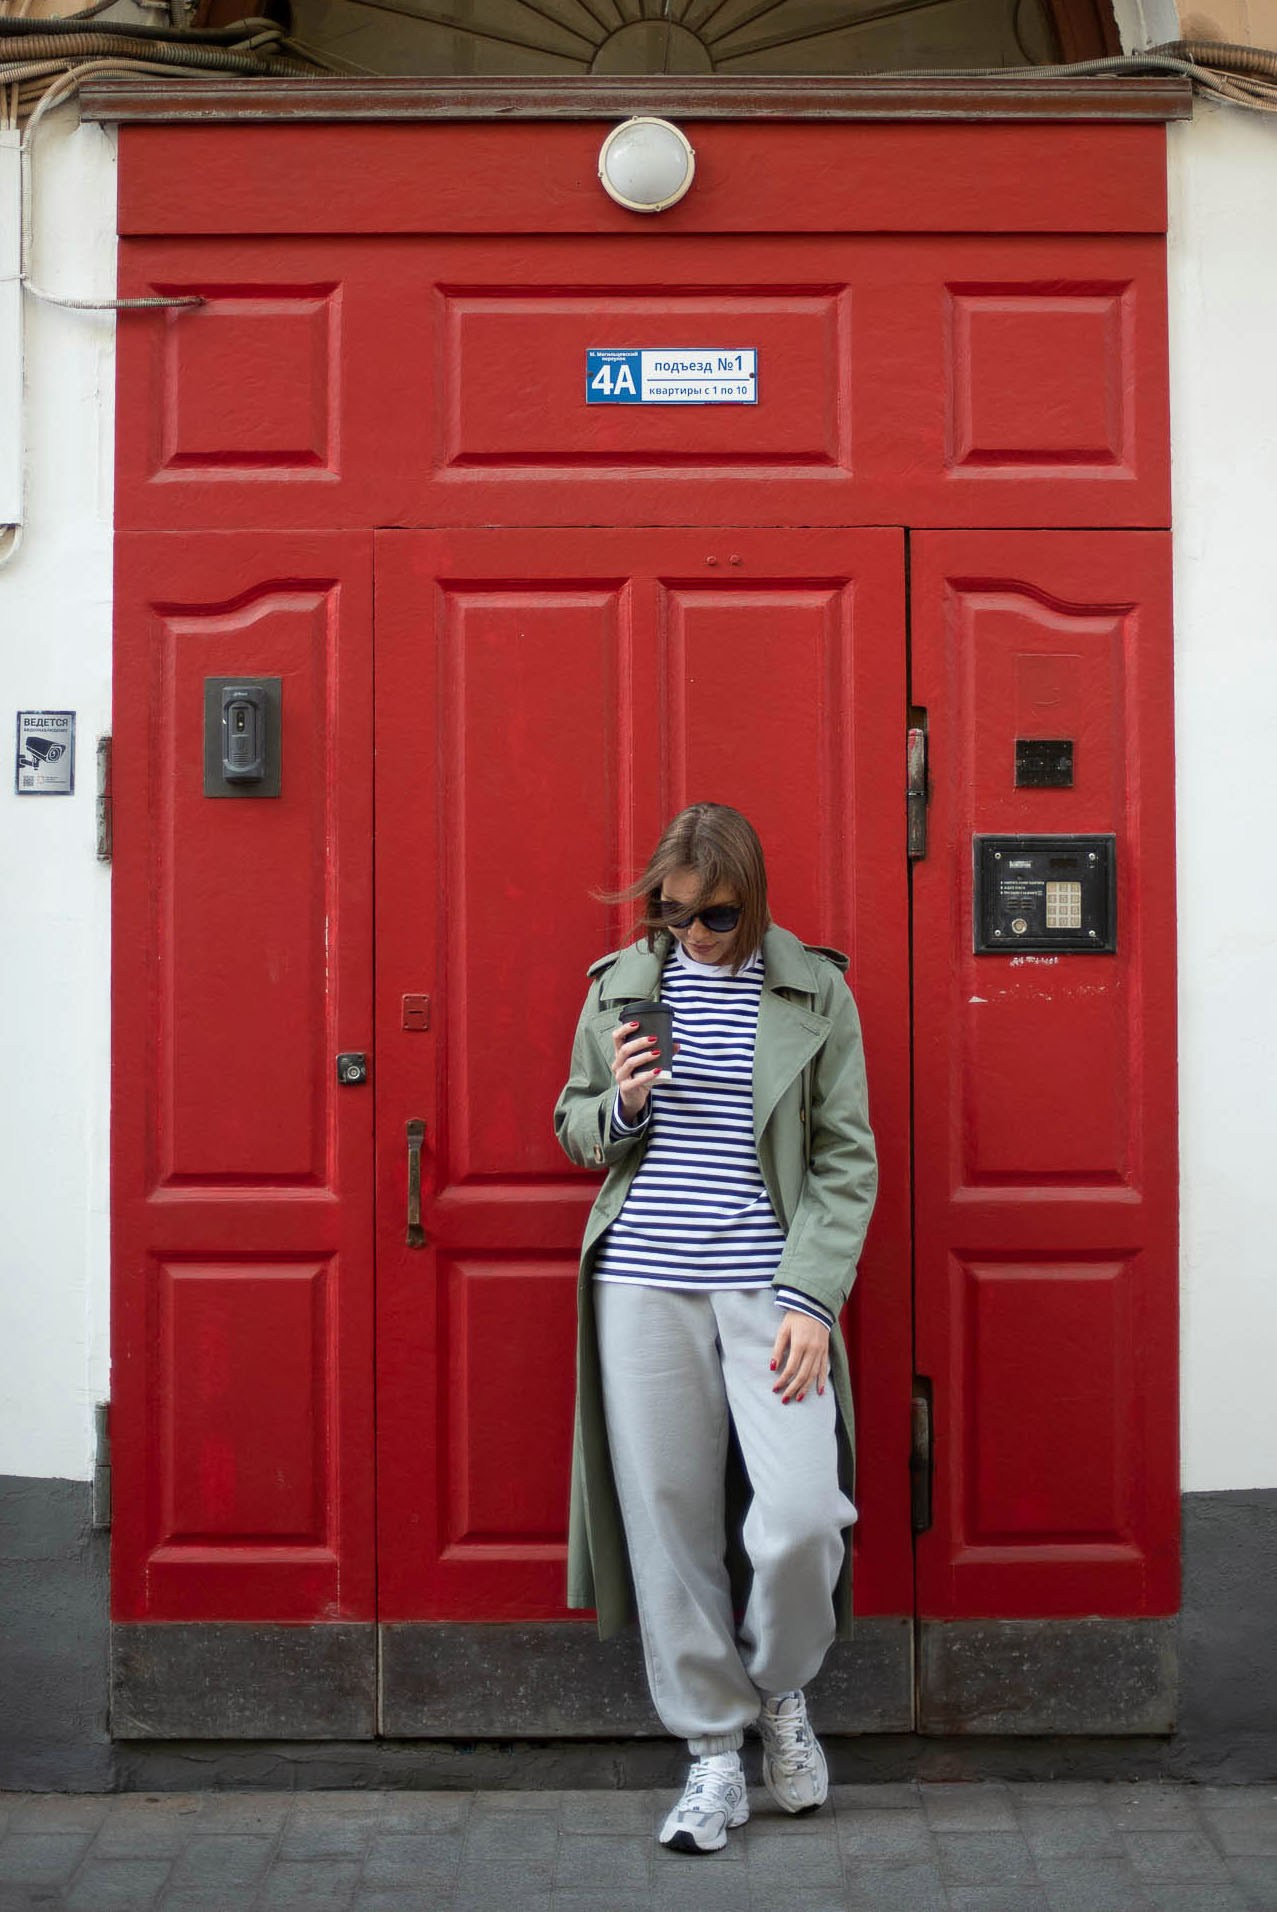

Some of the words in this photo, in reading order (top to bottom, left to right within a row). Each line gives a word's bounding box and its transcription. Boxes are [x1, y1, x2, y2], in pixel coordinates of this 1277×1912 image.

[654, 362, 713, 374] подъезд
[591, 364, 637, 395] 4А
[649, 386, 702, 397] квартиры
[705, 387, 710, 395] с
[713, 386, 717, 395] 1
[721, 387, 733, 395] по
[736, 386, 748, 395] 10
[24, 718, 68, 727] ВЕДЕТСЯ
